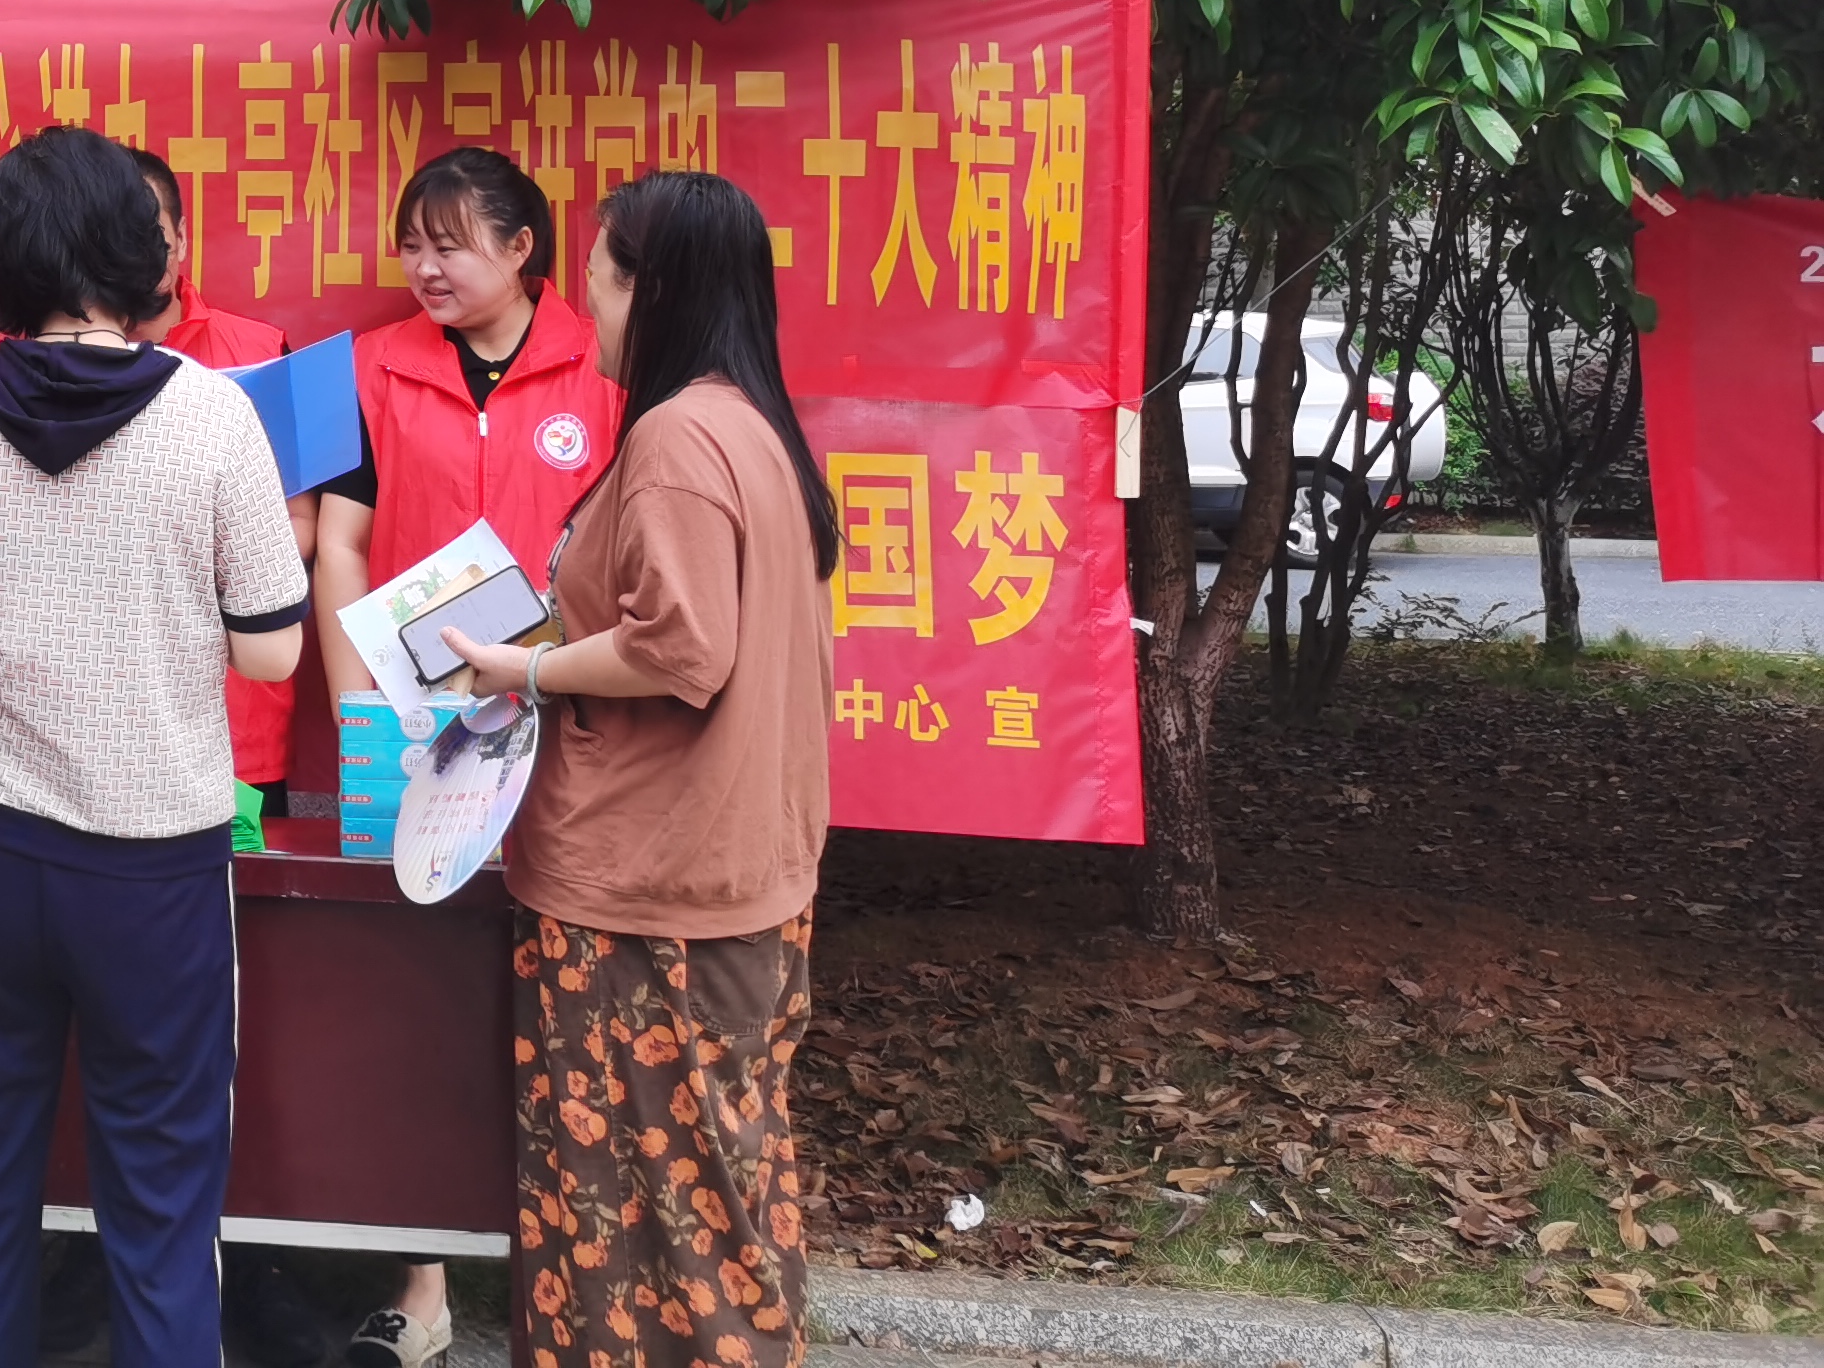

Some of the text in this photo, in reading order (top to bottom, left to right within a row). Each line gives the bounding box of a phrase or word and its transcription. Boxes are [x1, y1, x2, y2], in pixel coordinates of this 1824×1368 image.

[825, 450, 1069, 646] 国梦
[834, 678, 1041, 749] 中心 宣
